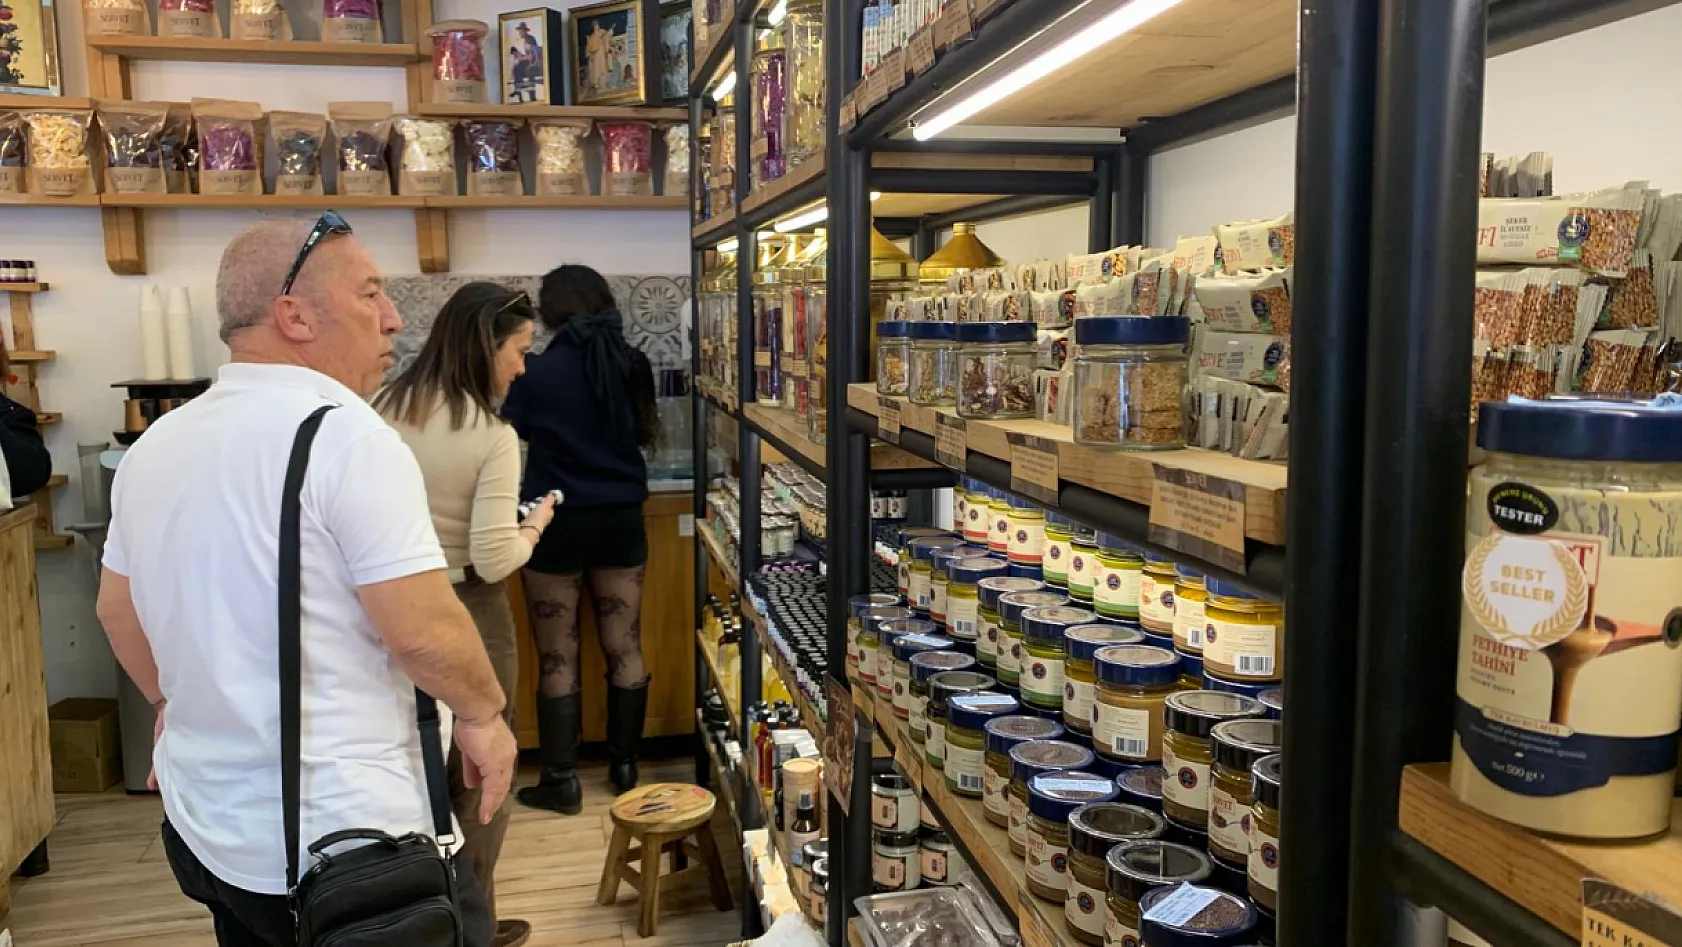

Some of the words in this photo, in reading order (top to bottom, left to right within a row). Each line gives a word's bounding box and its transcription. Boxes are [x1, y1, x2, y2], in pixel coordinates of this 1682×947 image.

[1493, 504, 1545, 527] TESTER
[1502, 564, 1547, 583] BEST
[1490, 580, 1556, 602] SELLER
[1588, 918, 1616, 942] TEK
